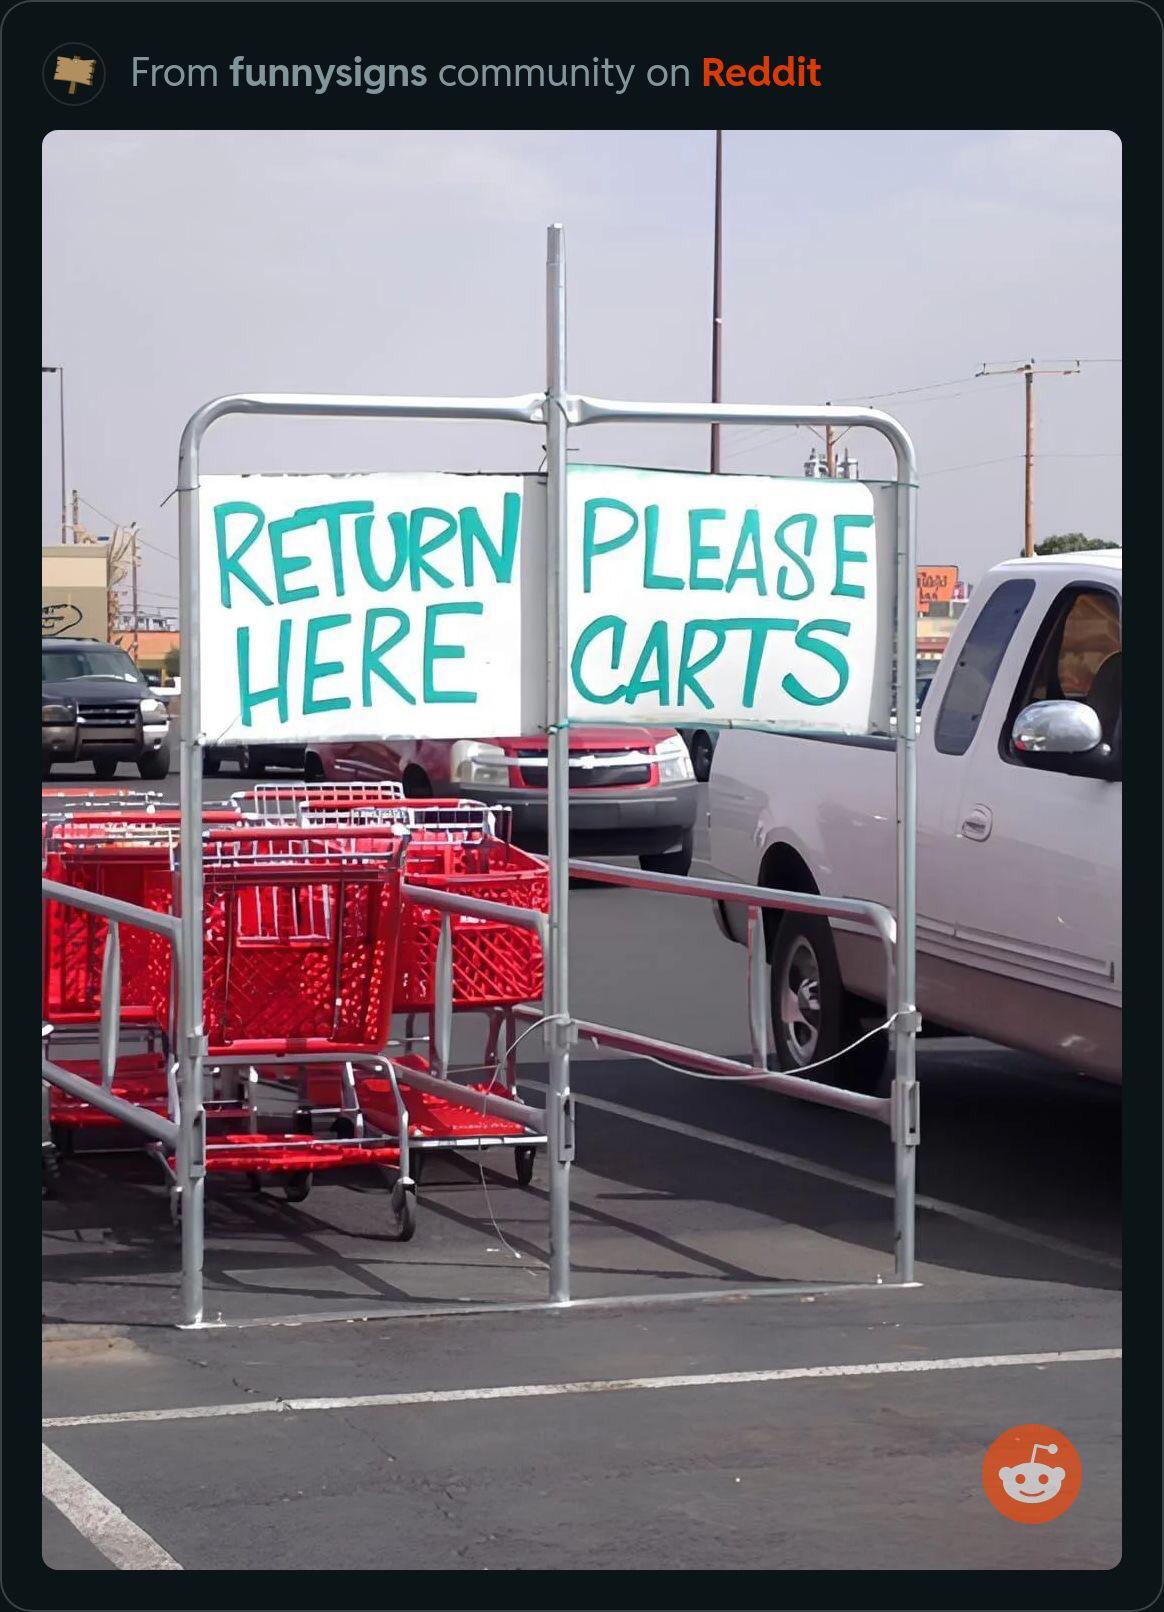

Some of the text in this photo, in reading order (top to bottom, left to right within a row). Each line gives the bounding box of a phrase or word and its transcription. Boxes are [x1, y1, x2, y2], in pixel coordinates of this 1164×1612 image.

[213, 492, 521, 608] RETURN
[583, 497, 874, 601] PLEASE
[236, 601, 484, 727] HERE
[571, 614, 851, 710] CARTS
